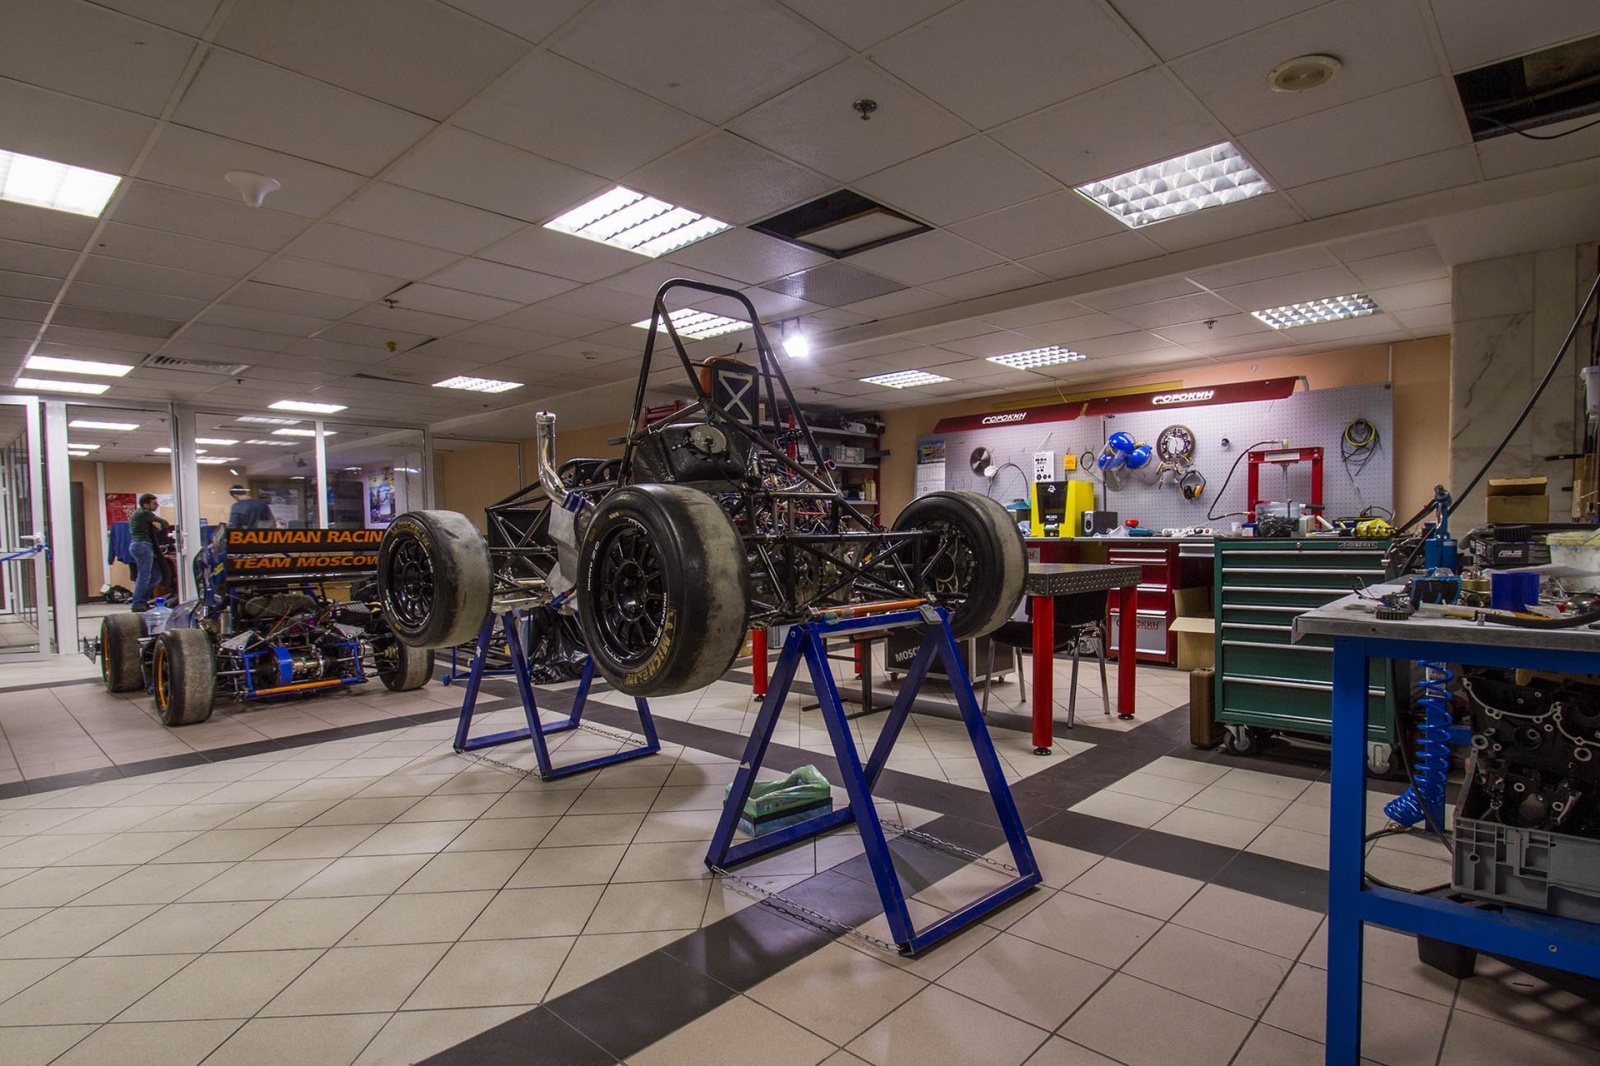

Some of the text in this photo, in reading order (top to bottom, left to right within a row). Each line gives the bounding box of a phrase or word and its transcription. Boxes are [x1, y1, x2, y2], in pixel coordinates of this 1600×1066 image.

[1152, 390, 1215, 405] СОРОКИН
[982, 412, 1027, 425] СОРОКИН
[229, 530, 383, 544] BAUMAN RACIN
[233, 556, 292, 569] TEAM
[895, 645, 920, 662] MOSC
